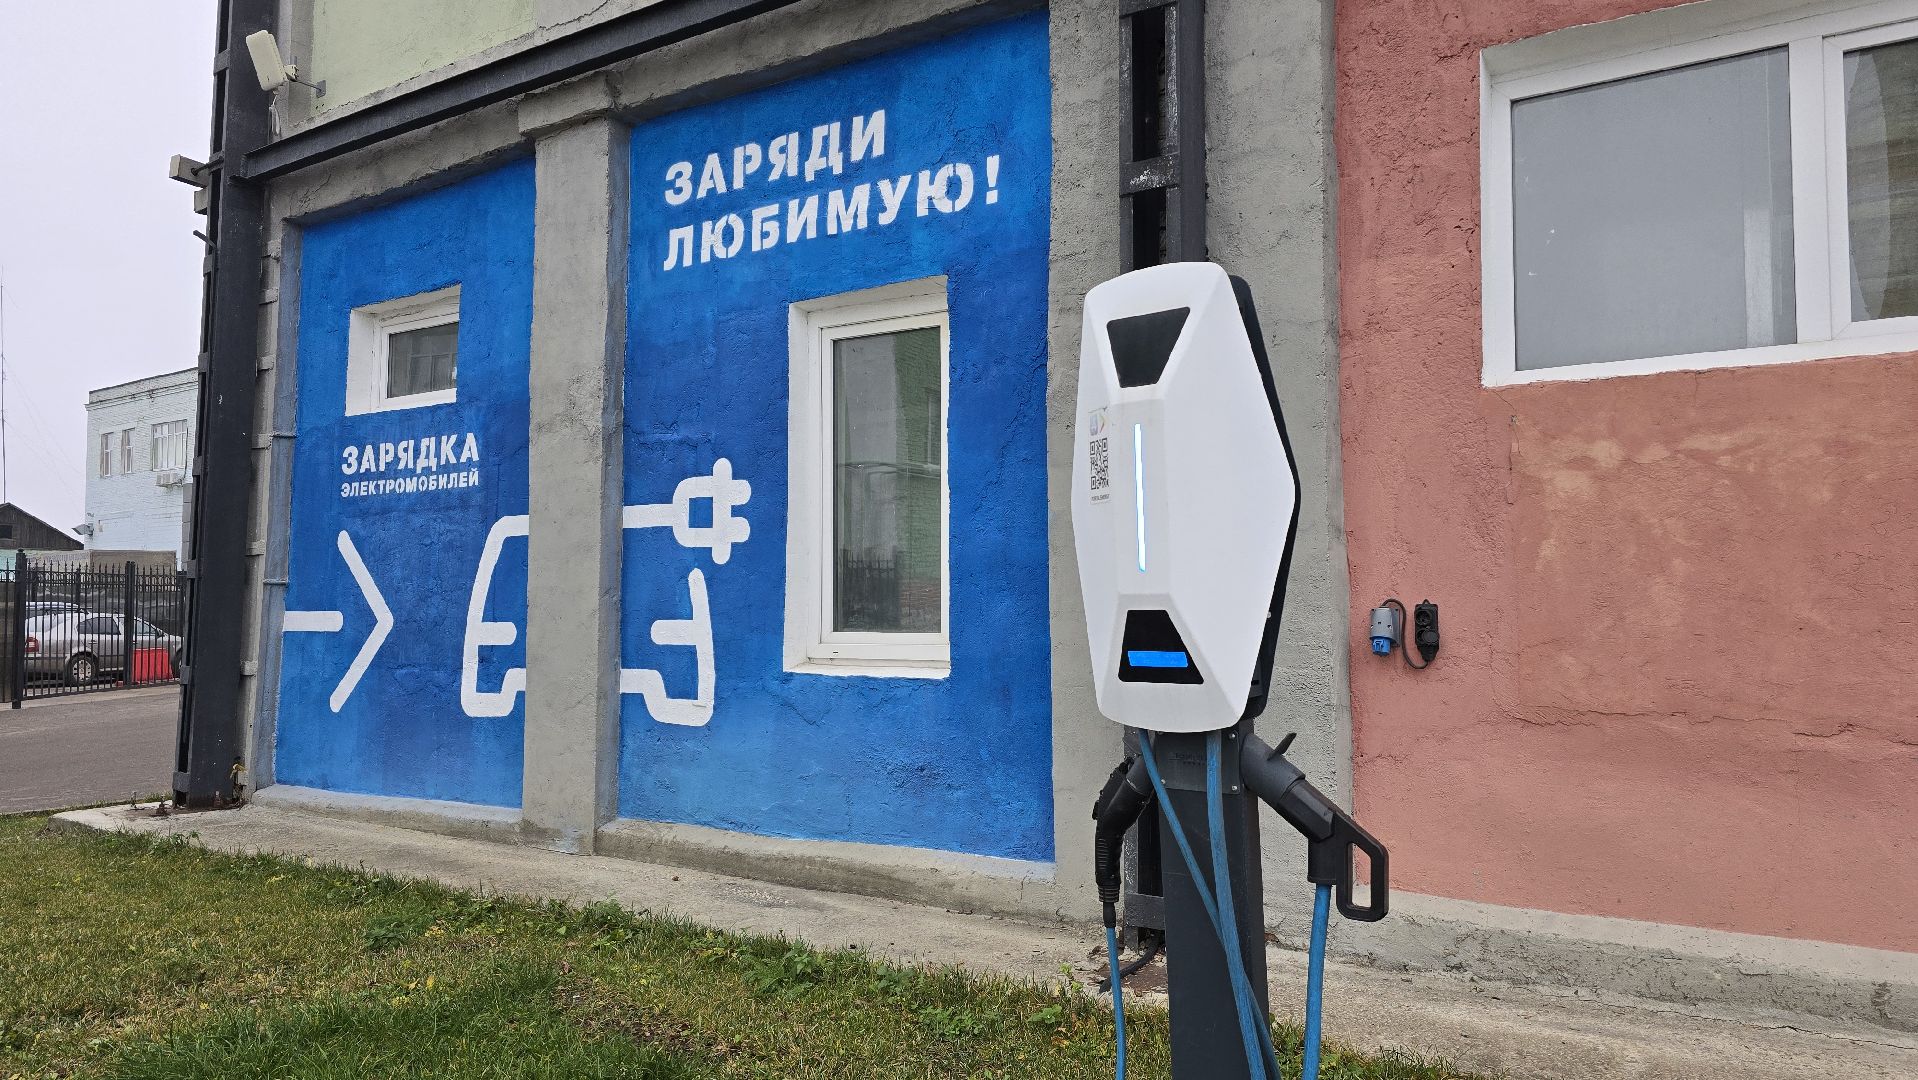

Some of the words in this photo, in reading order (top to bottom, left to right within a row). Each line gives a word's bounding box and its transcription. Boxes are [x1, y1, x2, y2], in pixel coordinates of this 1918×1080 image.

[664, 109, 886, 205] ЗАРЯДИ
[663, 154, 1000, 271] ЛЮБИМУЮ!
[340, 467, 480, 498] ЭЛЕКТРОМОБИЛЕЙ
[341, 432, 480, 475] ЗАРЯДКА
